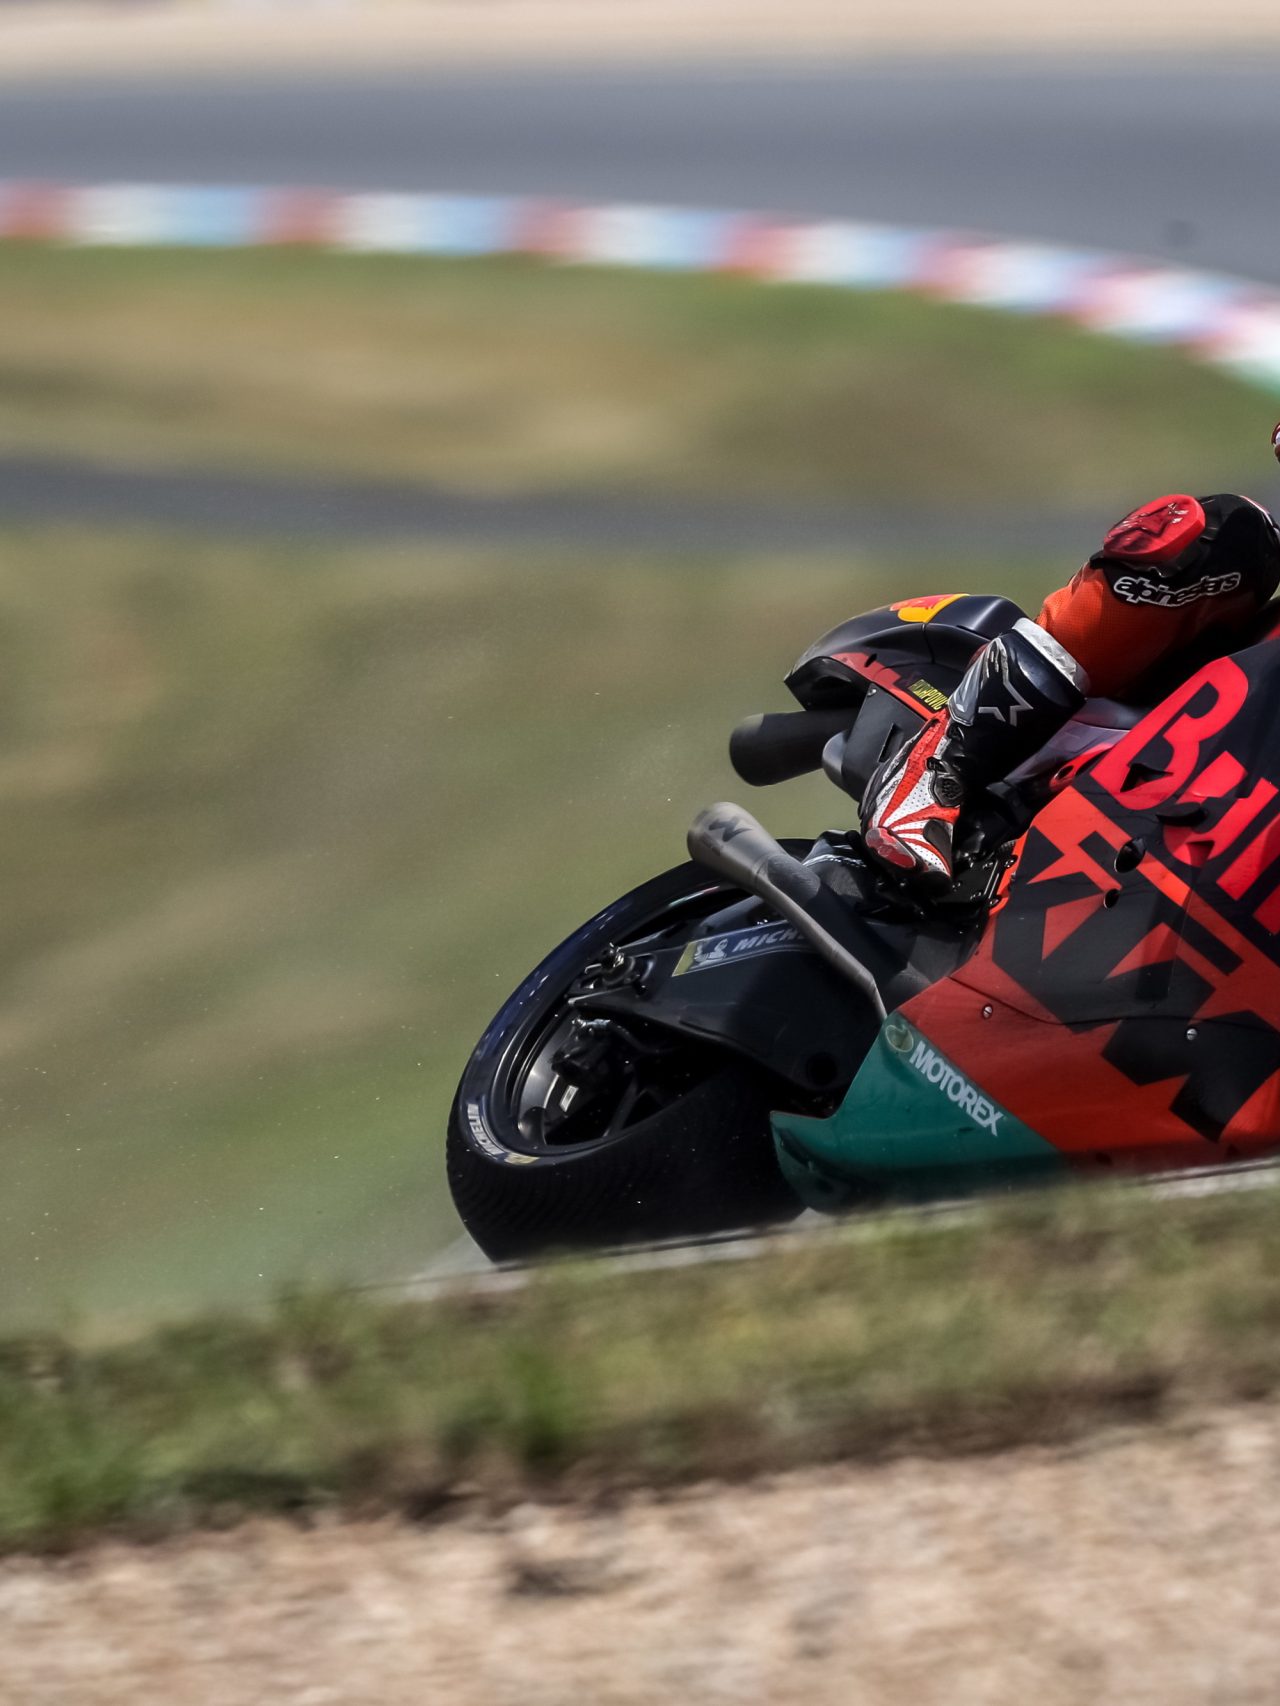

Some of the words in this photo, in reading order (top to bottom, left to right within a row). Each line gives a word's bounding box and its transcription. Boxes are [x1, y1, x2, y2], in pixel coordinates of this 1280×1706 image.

[1113, 572, 1241, 607] alpinestars
[732, 926, 804, 953] MICH
[908, 1039, 1004, 1137] MOTOREX
